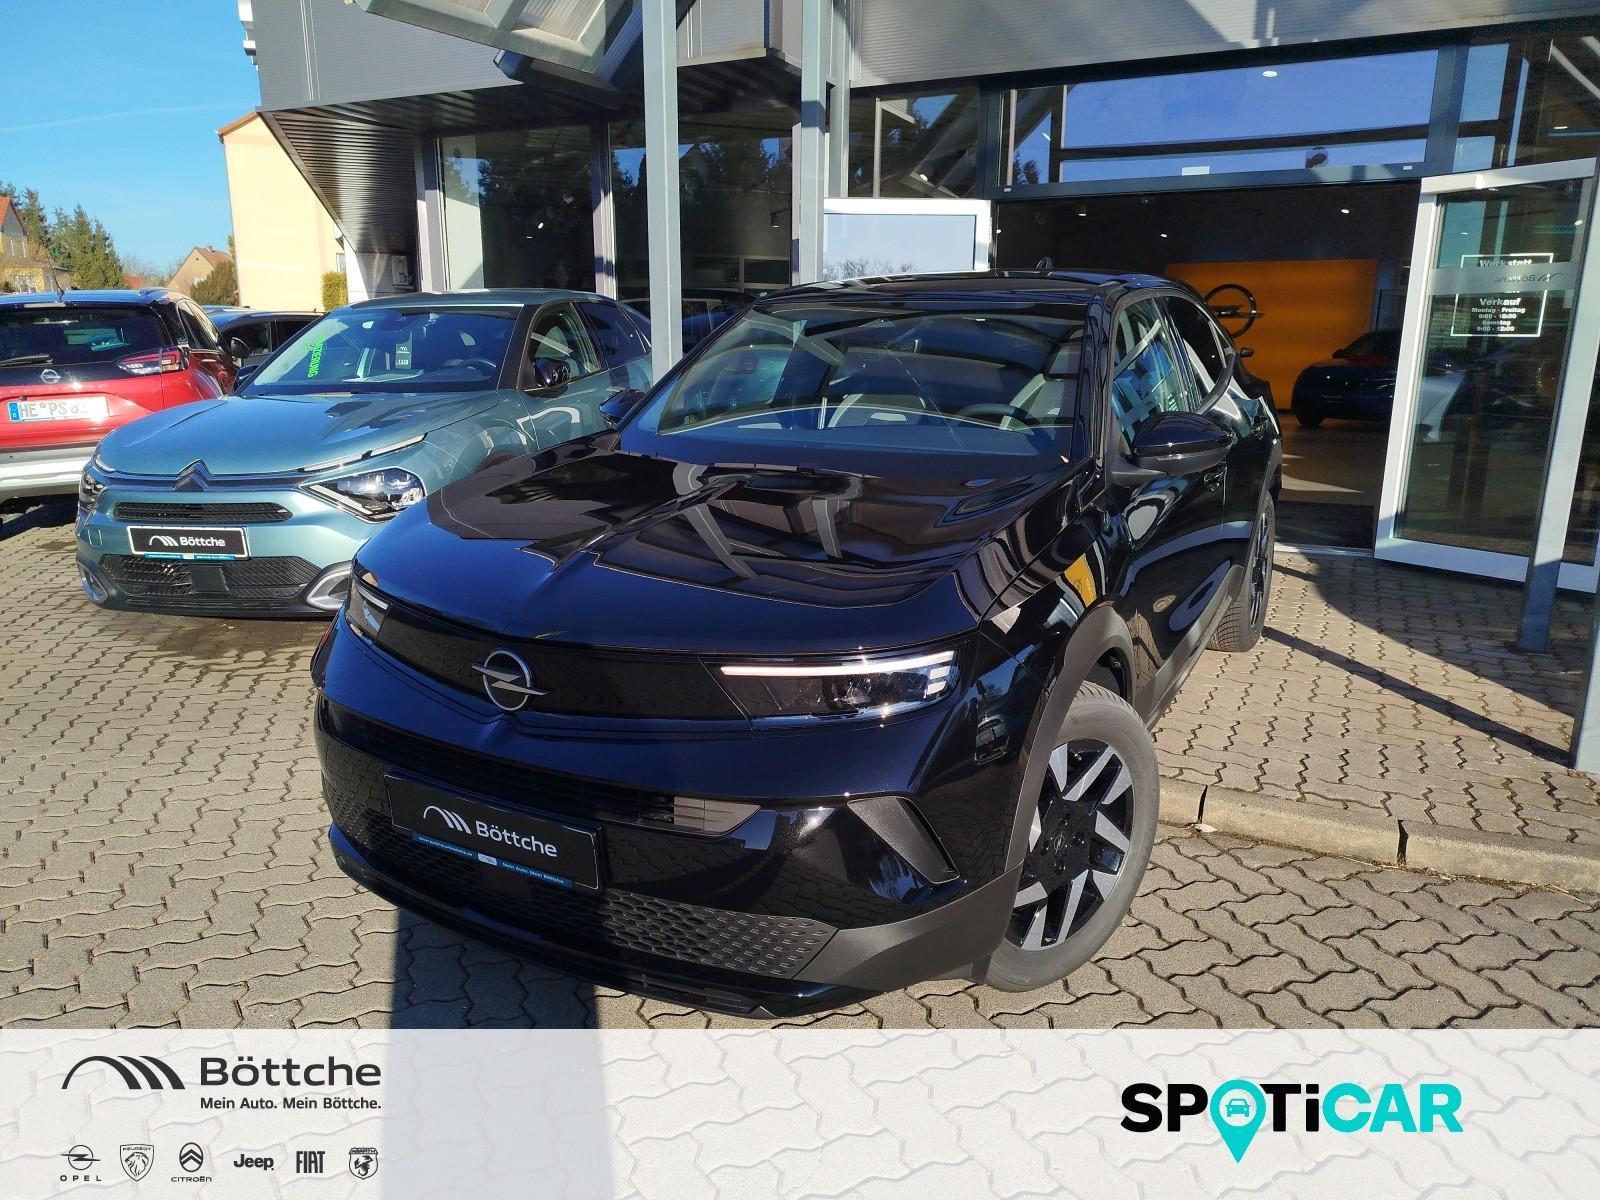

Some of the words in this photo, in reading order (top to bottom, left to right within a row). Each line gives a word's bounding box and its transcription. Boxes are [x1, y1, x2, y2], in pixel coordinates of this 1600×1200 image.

[1480, 298, 1522, 306] Verkauf
[19, 403, 39, 418] HE
[48, 401, 68, 416] PS
[179, 536, 226, 547] Böttche
[475, 820, 558, 857] Böttche
